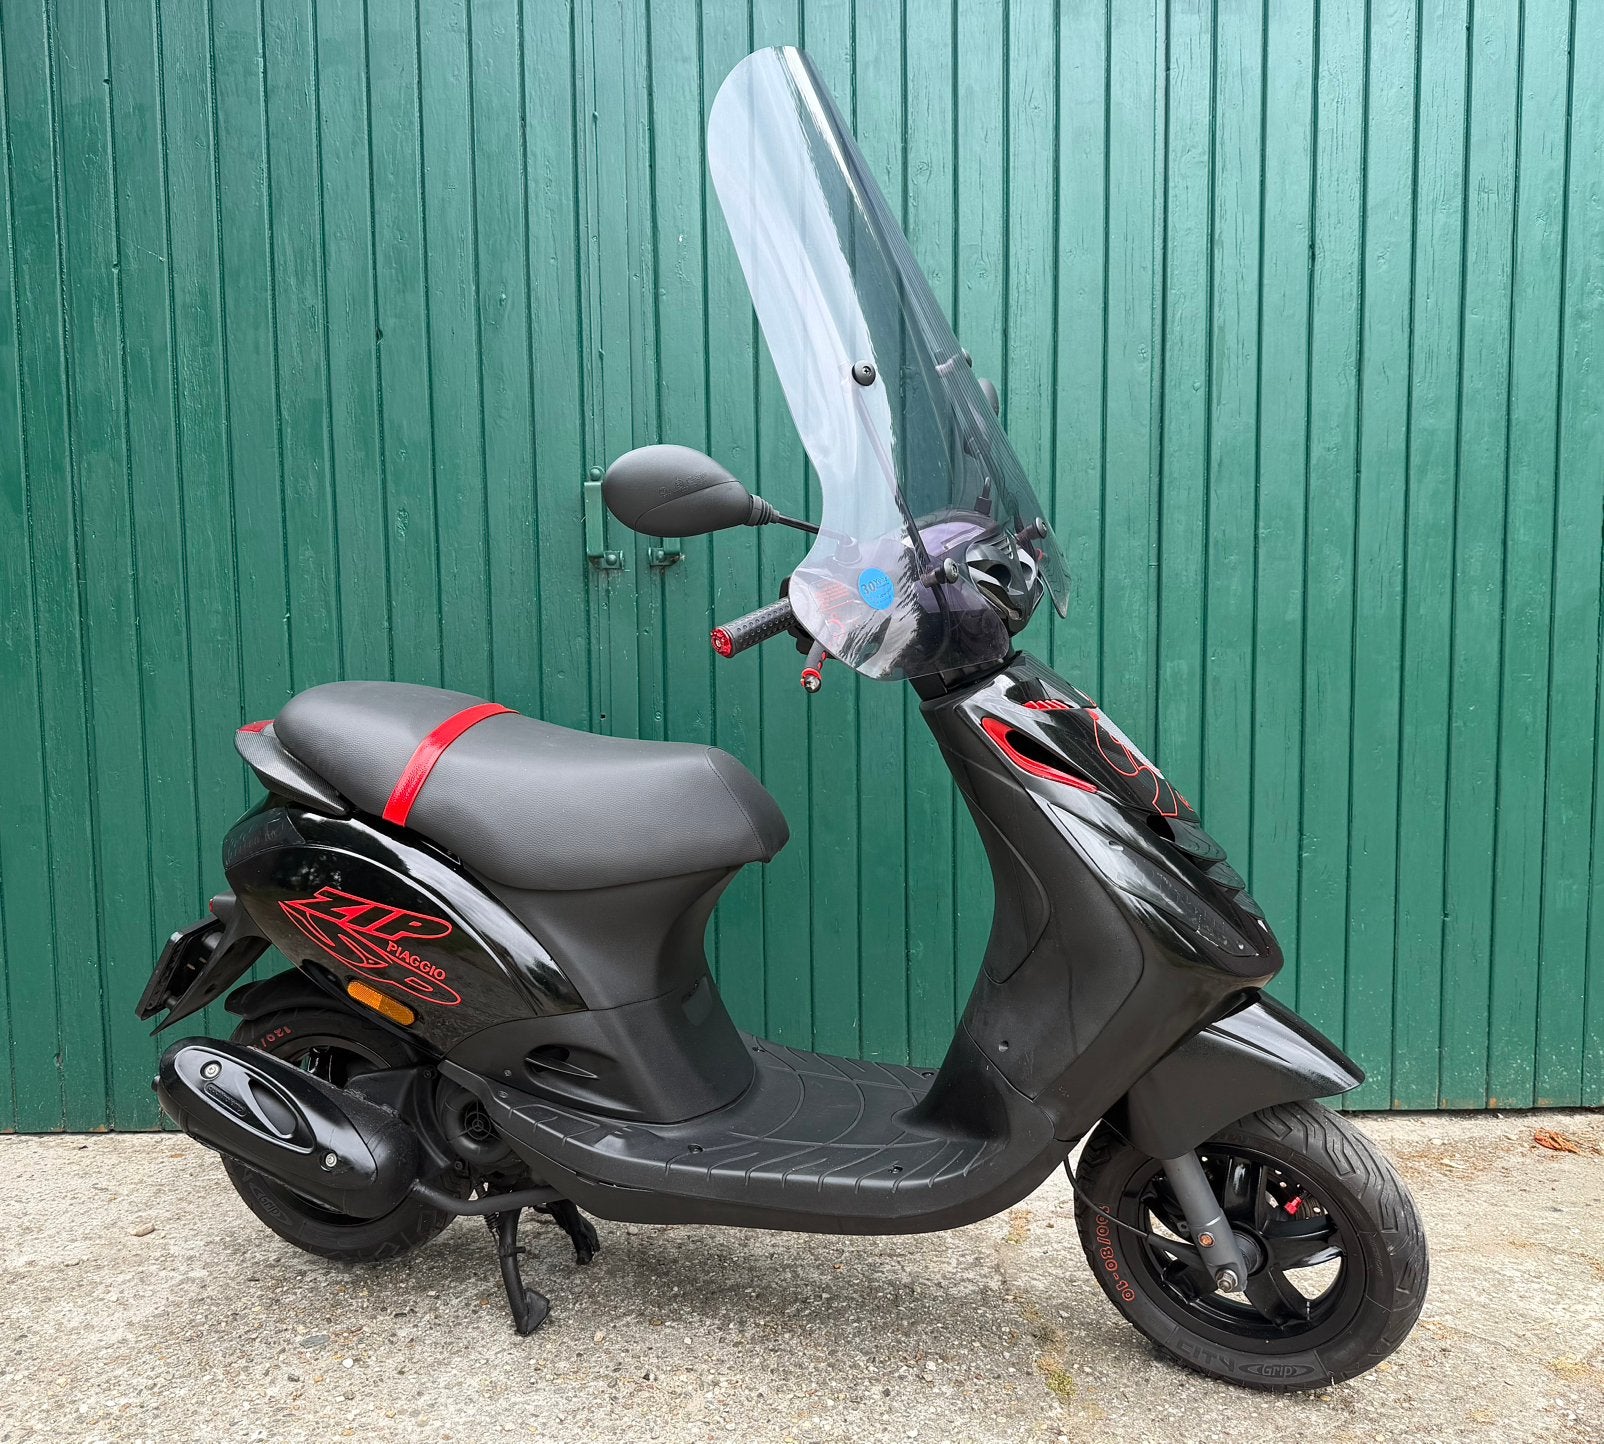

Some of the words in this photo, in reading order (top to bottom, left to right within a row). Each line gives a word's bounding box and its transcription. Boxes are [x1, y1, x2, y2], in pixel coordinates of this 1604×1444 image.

[283, 885, 453, 941] ZIP
[385, 940, 447, 981] PIAGGIO
[254, 1026, 292, 1048] 120/
[1261, 1363, 1295, 1379] Grip
